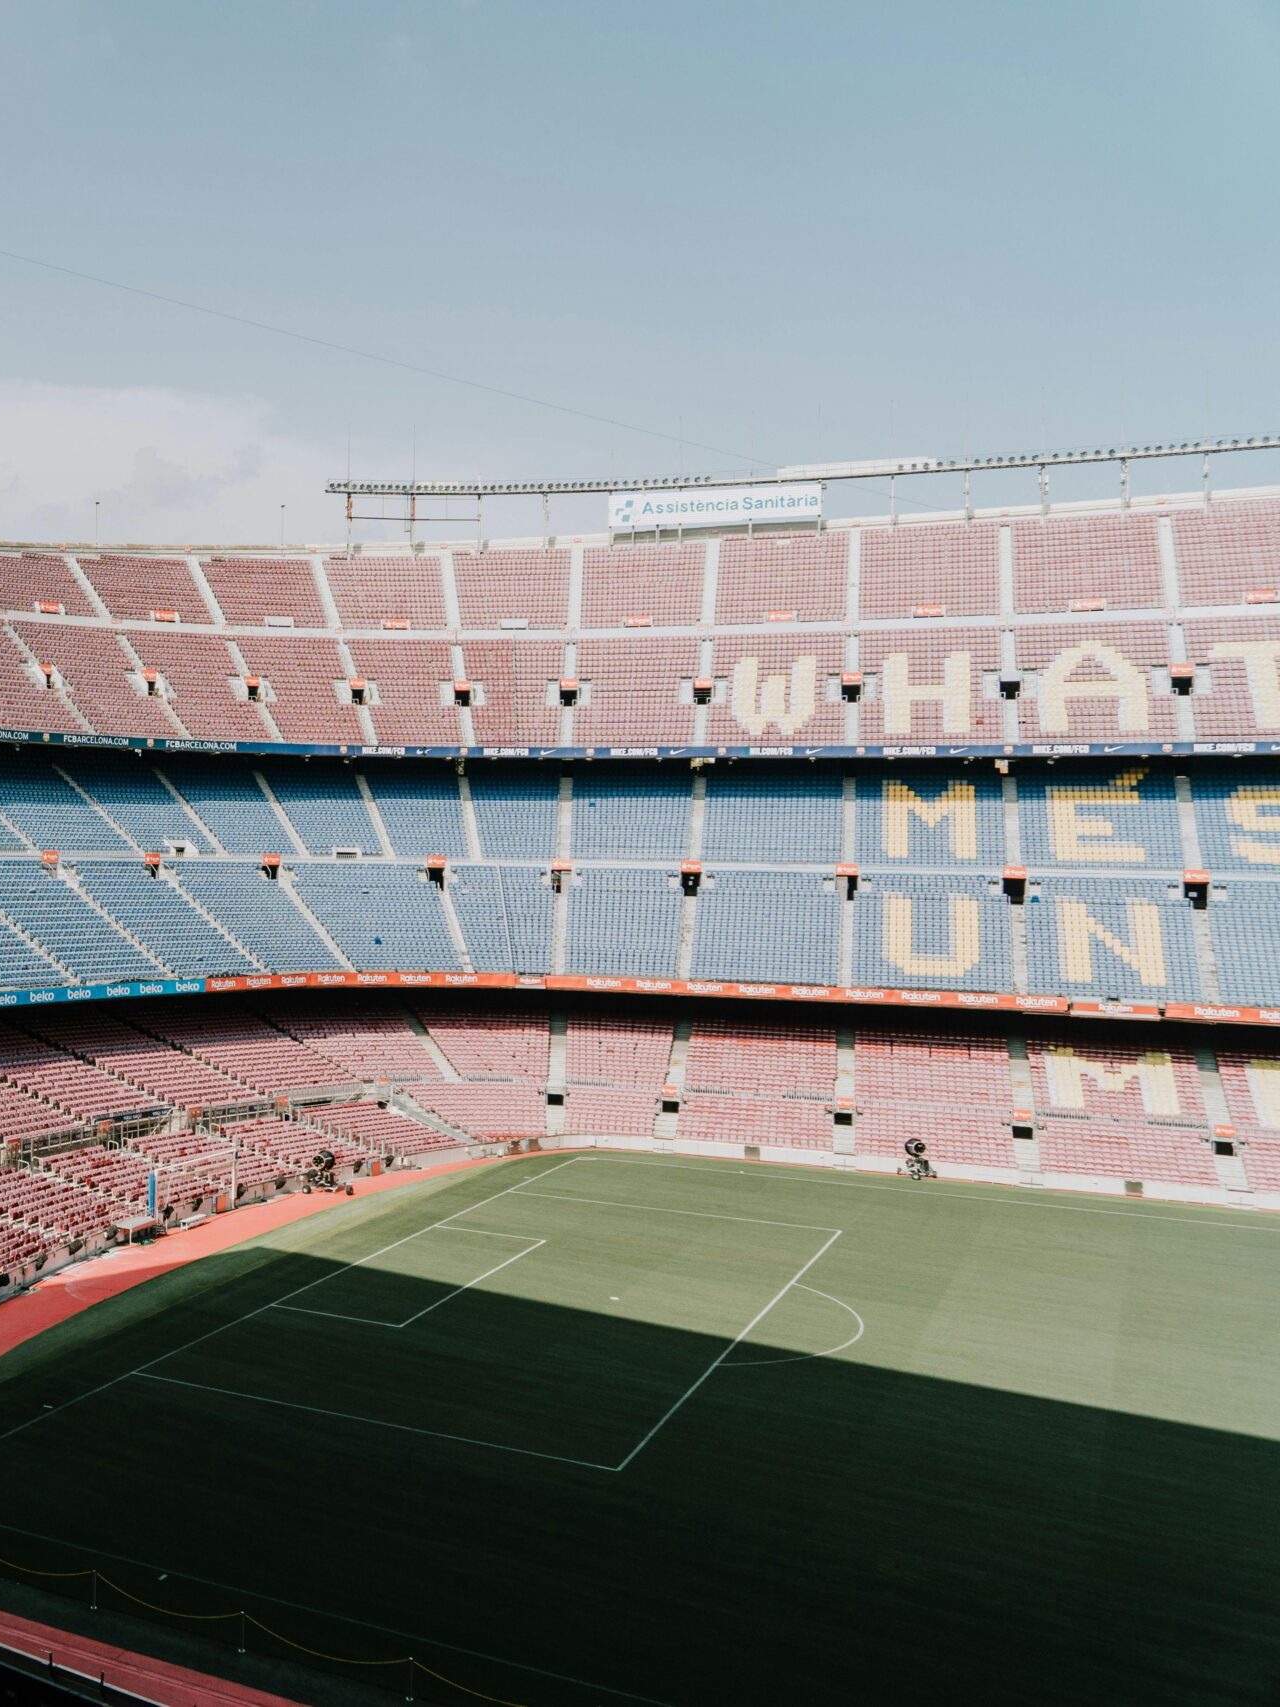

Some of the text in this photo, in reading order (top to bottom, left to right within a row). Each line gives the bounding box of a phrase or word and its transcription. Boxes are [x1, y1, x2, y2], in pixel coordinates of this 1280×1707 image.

[63, 734, 129, 747] FCBARCELONA.COM
[166, 739, 235, 752] FCBARCELONA.COM
[883, 892, 1168, 986] UN
[246, 976, 271, 987] Rakuten
[281, 975, 307, 985] Rakuten
[317, 973, 346, 984] Rakuten
[357, 973, 387, 983] Rakuten
[400, 973, 431, 983] Rakuten
[445, 974, 478, 984] Rakuten
[586, 978, 621, 989] Rakuten
[139, 981, 164, 994] beko
[176, 979, 200, 993] beko
[211, 979, 236, 990] Rakuten
[636, 980, 671, 990] Rakuten
[687, 982, 723, 992] Rakuten
[739, 985, 776, 995] Rakuten
[30, 989, 55, 1003] beko
[67, 987, 91, 1000] beko
[106, 984, 131, 997] beko
[792, 986, 829, 996] Rakuten
[845, 989, 884, 999] Rakuten
[901, 991, 941, 1002] Rakuten
[958, 993, 998, 1004] Rakuten
[1016, 997, 1057, 1007] Rakuten
[1098, 1003, 1133, 1013] Rakuten
[1194, 1006, 1240, 1018] Rakuten
